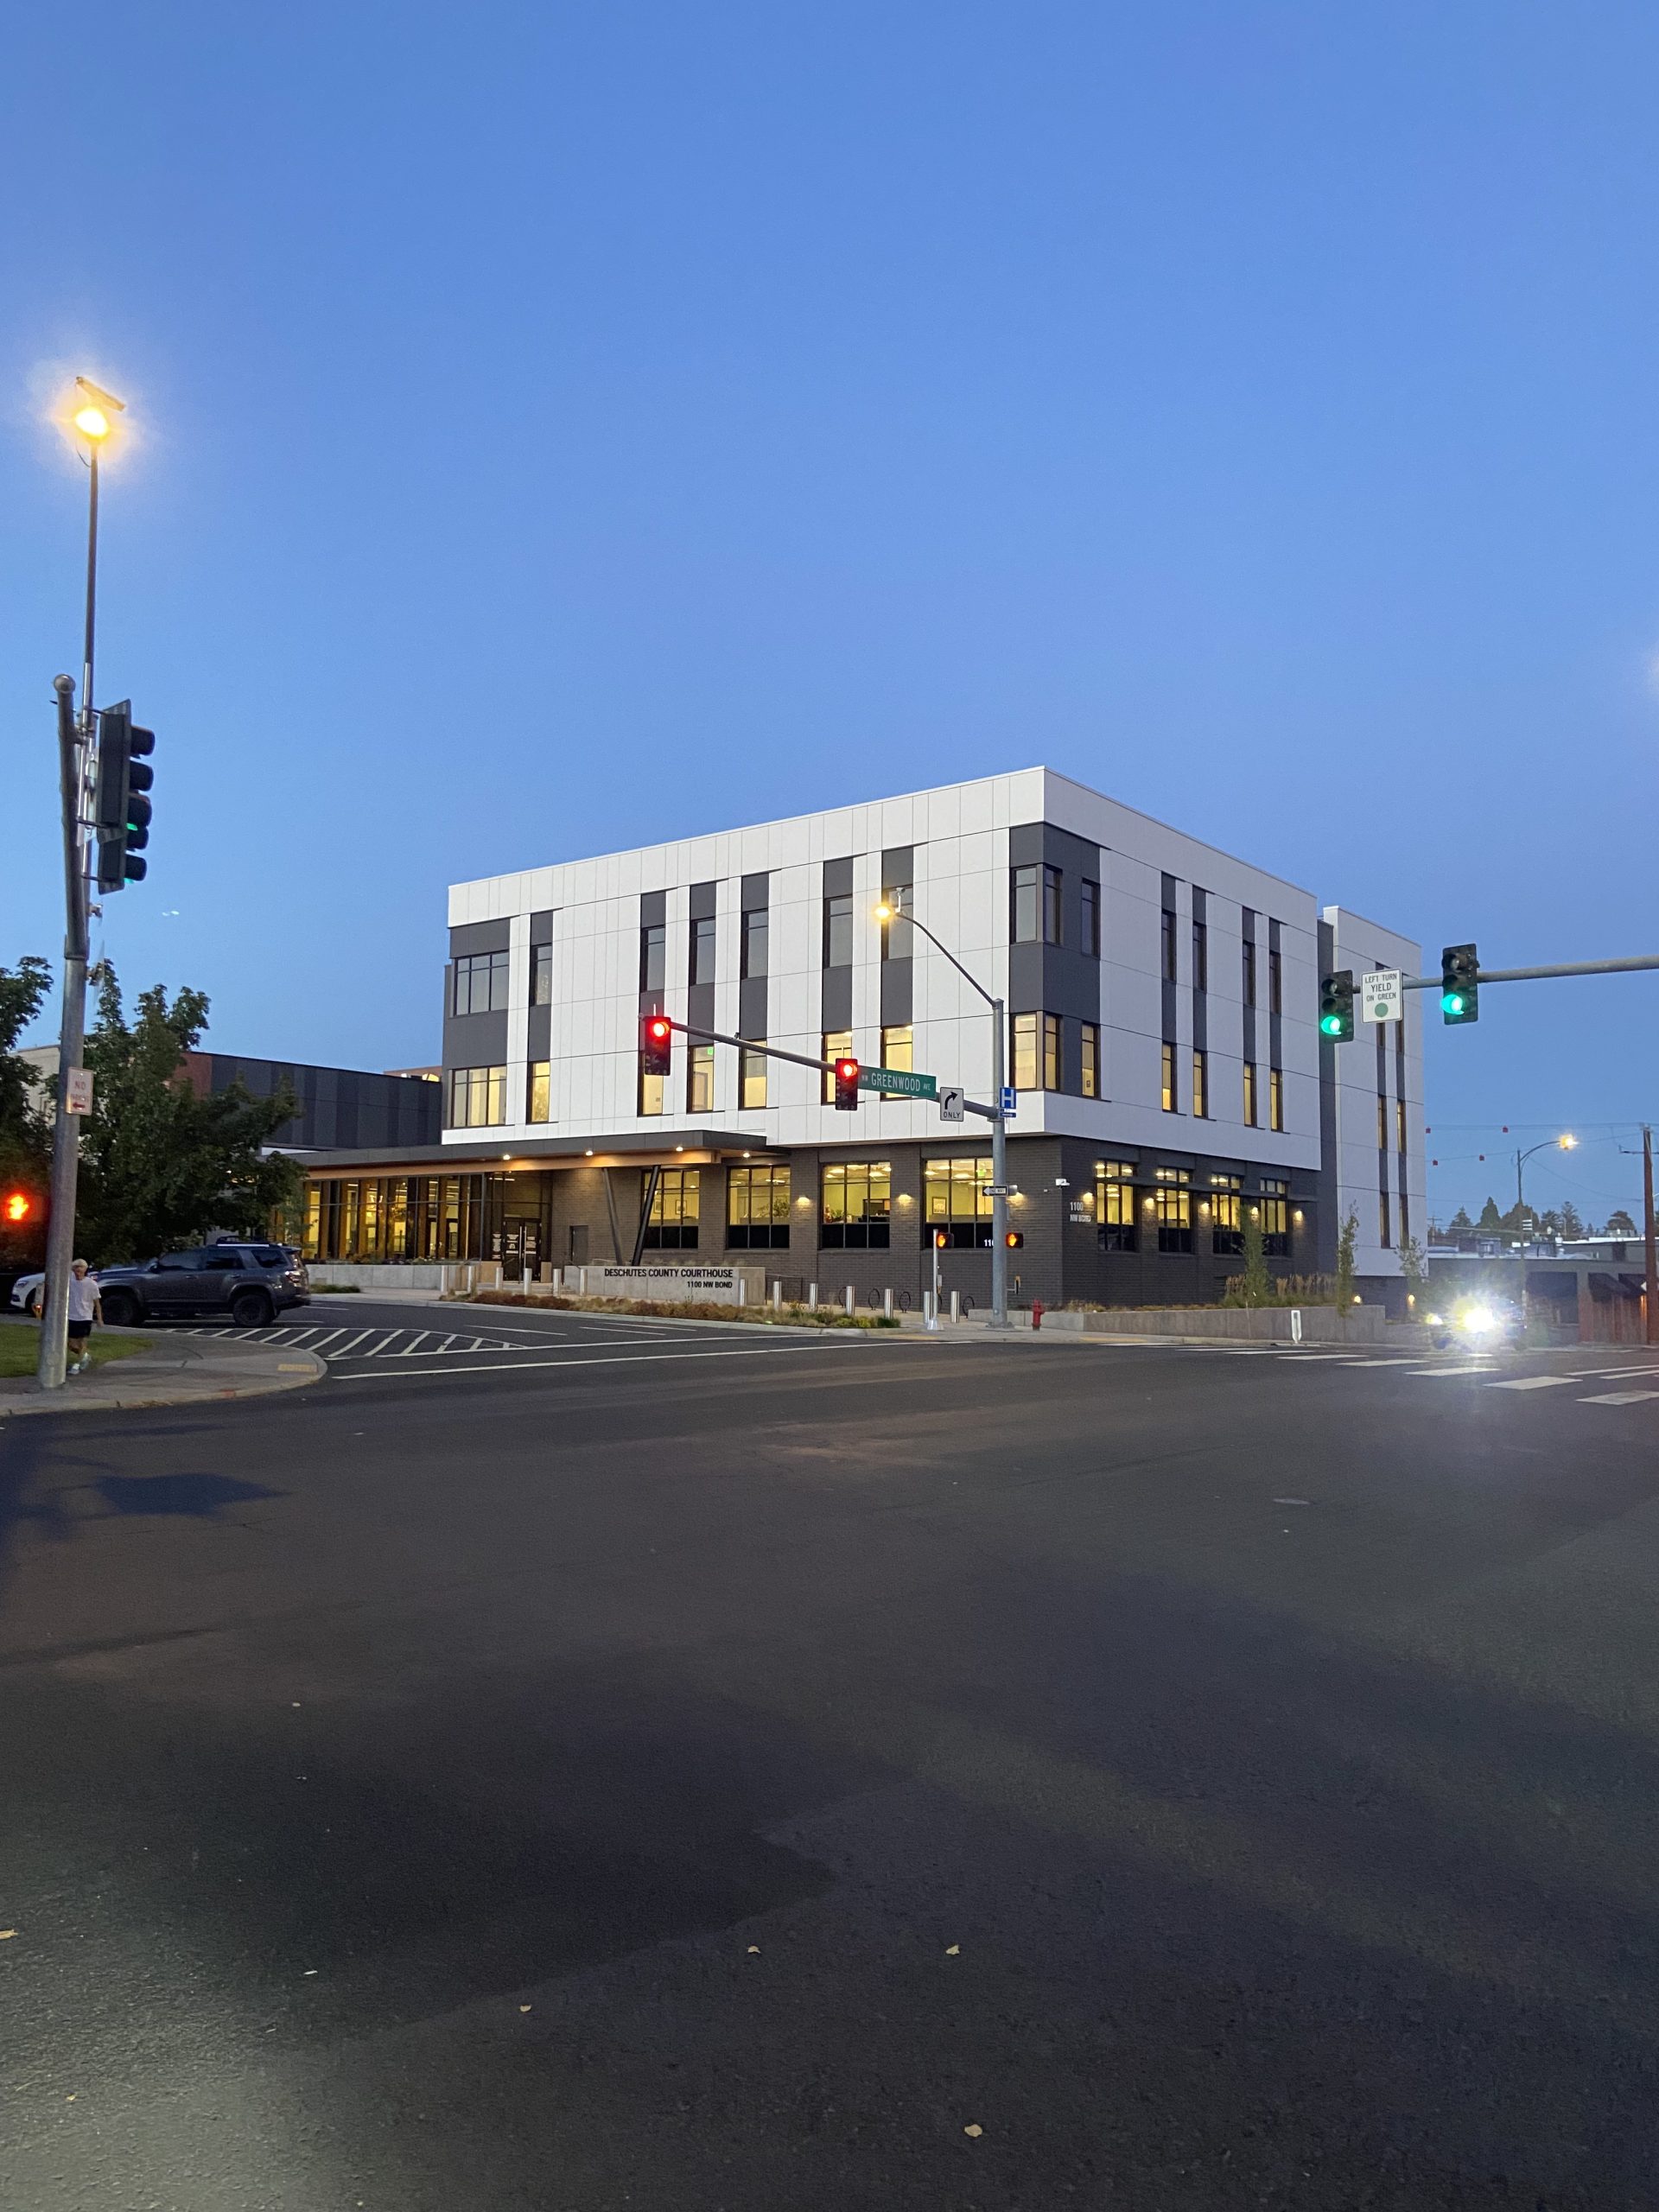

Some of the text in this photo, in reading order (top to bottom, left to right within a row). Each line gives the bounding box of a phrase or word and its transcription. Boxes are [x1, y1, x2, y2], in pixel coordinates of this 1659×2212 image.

[1382, 973, 1397, 982] TURN
[1370, 982, 1392, 993] YIELD
[1377, 992, 1396, 1001] GREEN
[871, 1072, 921, 1092] GREENWOOD
[1070, 1201, 1084, 1211] 1100
[604, 1268, 734, 1278] DESCHUTES COUNTY COURTHOUSE
